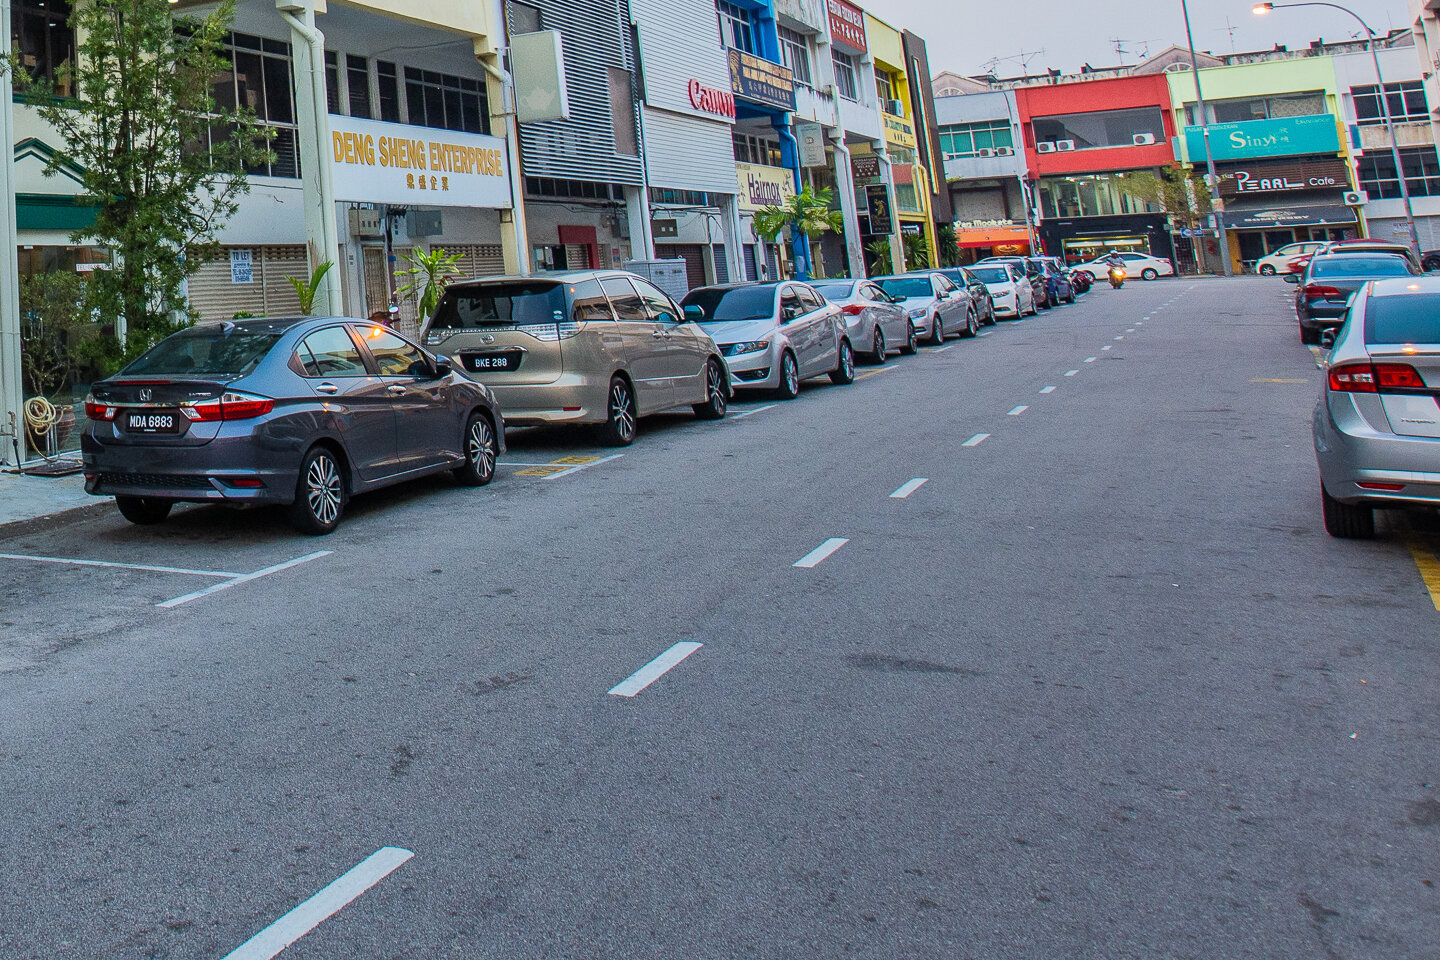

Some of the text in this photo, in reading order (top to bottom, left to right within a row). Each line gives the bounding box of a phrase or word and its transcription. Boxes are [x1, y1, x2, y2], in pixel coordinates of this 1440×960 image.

[688, 78, 736, 118] Canon
[332, 130, 504, 176] DENG SHENG ENTERPRISE
[747, 172, 781, 200] Hairnox
[1235, 171, 1305, 190] PEARL
[1308, 177, 1336, 186] Cafe
[232, 251, 250, 260] TO LET
[474, 358, 490, 368] BKE
[130, 416, 173, 428] MDA 6883
